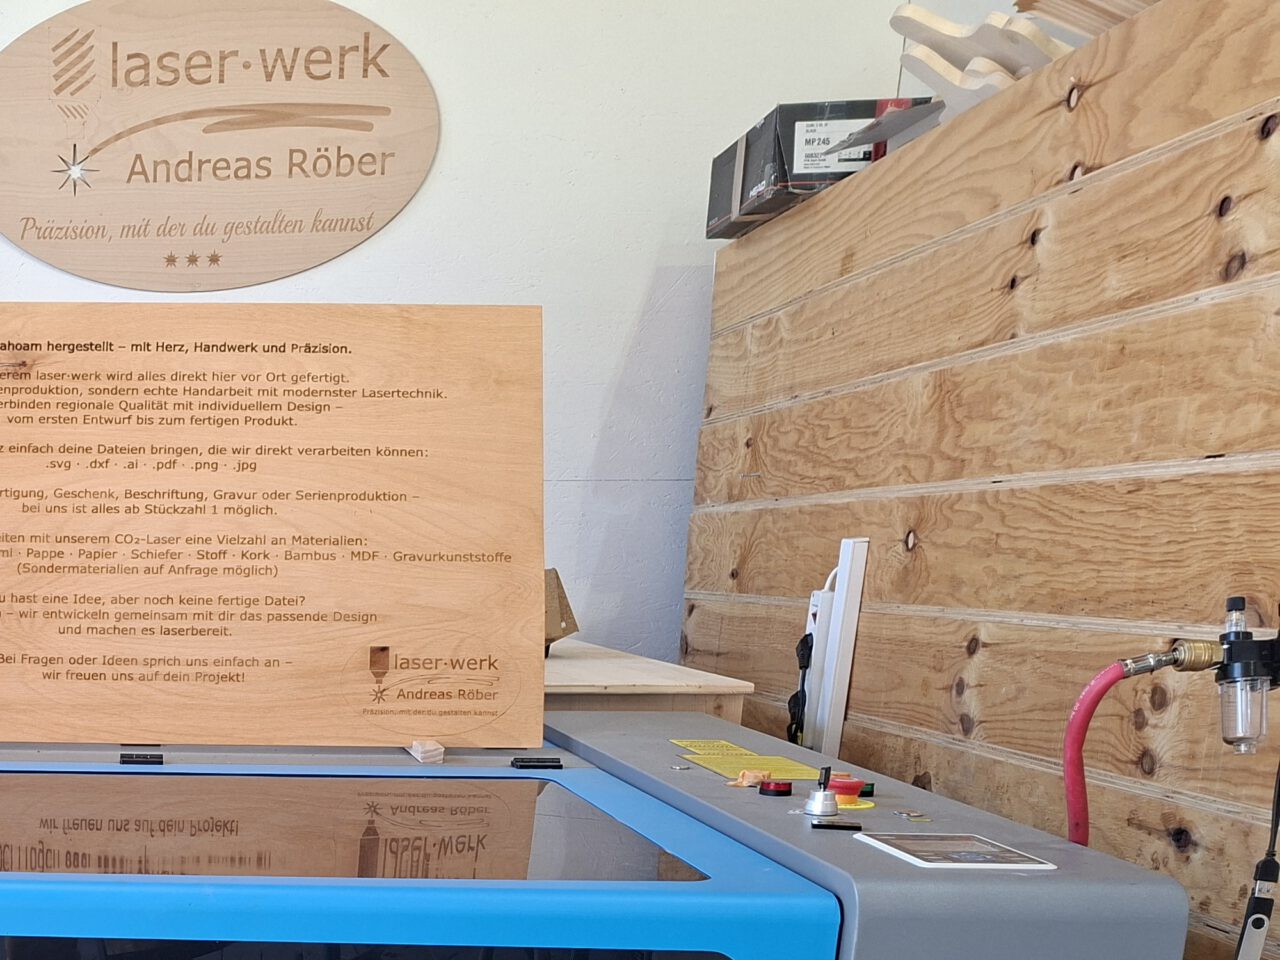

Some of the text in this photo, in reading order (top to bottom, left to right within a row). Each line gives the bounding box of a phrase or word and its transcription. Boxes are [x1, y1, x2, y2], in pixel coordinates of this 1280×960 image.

[804, 137, 831, 146] MP 245
[126, 147, 395, 184] Andreas Röber
[20, 208, 376, 243] Präzision, mit der du gestalten kannst
[46, 340, 114, 354] hergestellt
[130, 341, 152, 352] mit
[155, 341, 189, 355] Herz,
[193, 341, 258, 353] Handwerk
[262, 341, 286, 353] und
[290, 342, 352, 354] Präzision.
[87, 384, 139, 396] sondern
[143, 385, 178, 396] echte
[182, 385, 253, 397] Handarbeit
[257, 386, 278, 397] mit
[282, 387, 358, 398] modernster
[361, 387, 448, 399] Lasertechnik.
[6, 414, 298, 428] vom ersten Entwurf bis zum fertigen Produkt.
[45, 457, 257, 473] .svg .dxf .ai .pdf .png .jpg
[53, 487, 119, 501] Geschenk,
[124, 488, 208, 502] Beschriftung,
[212, 489, 258, 500] Gravur
[261, 489, 292, 500] oder
[294, 490, 407, 503] Serienproduktion
[29, 532, 51, 543] mit
[54, 535, 110, 544] unserem
[184, 534, 212, 545] eine
[216, 533, 266, 545] Vielzahl
[270, 536, 286, 546] an
[291, 535, 368, 546] Materialien:
[26, 547, 65, 561] Pappe
[78, 547, 118, 561] Papier
[130, 548, 184, 560] Schiefer
[196, 548, 228, 560] Stoff
[240, 549, 270, 560] Kork
[284, 549, 336, 561] Bambus
[350, 550, 380, 561] MDF
[392, 550, 512, 563] Gravurkunststoffe
[16, 562, 278, 578] (Sondermaterialien auf Anfrage möglich)
[396, 688, 499, 701] Andreas Röber
